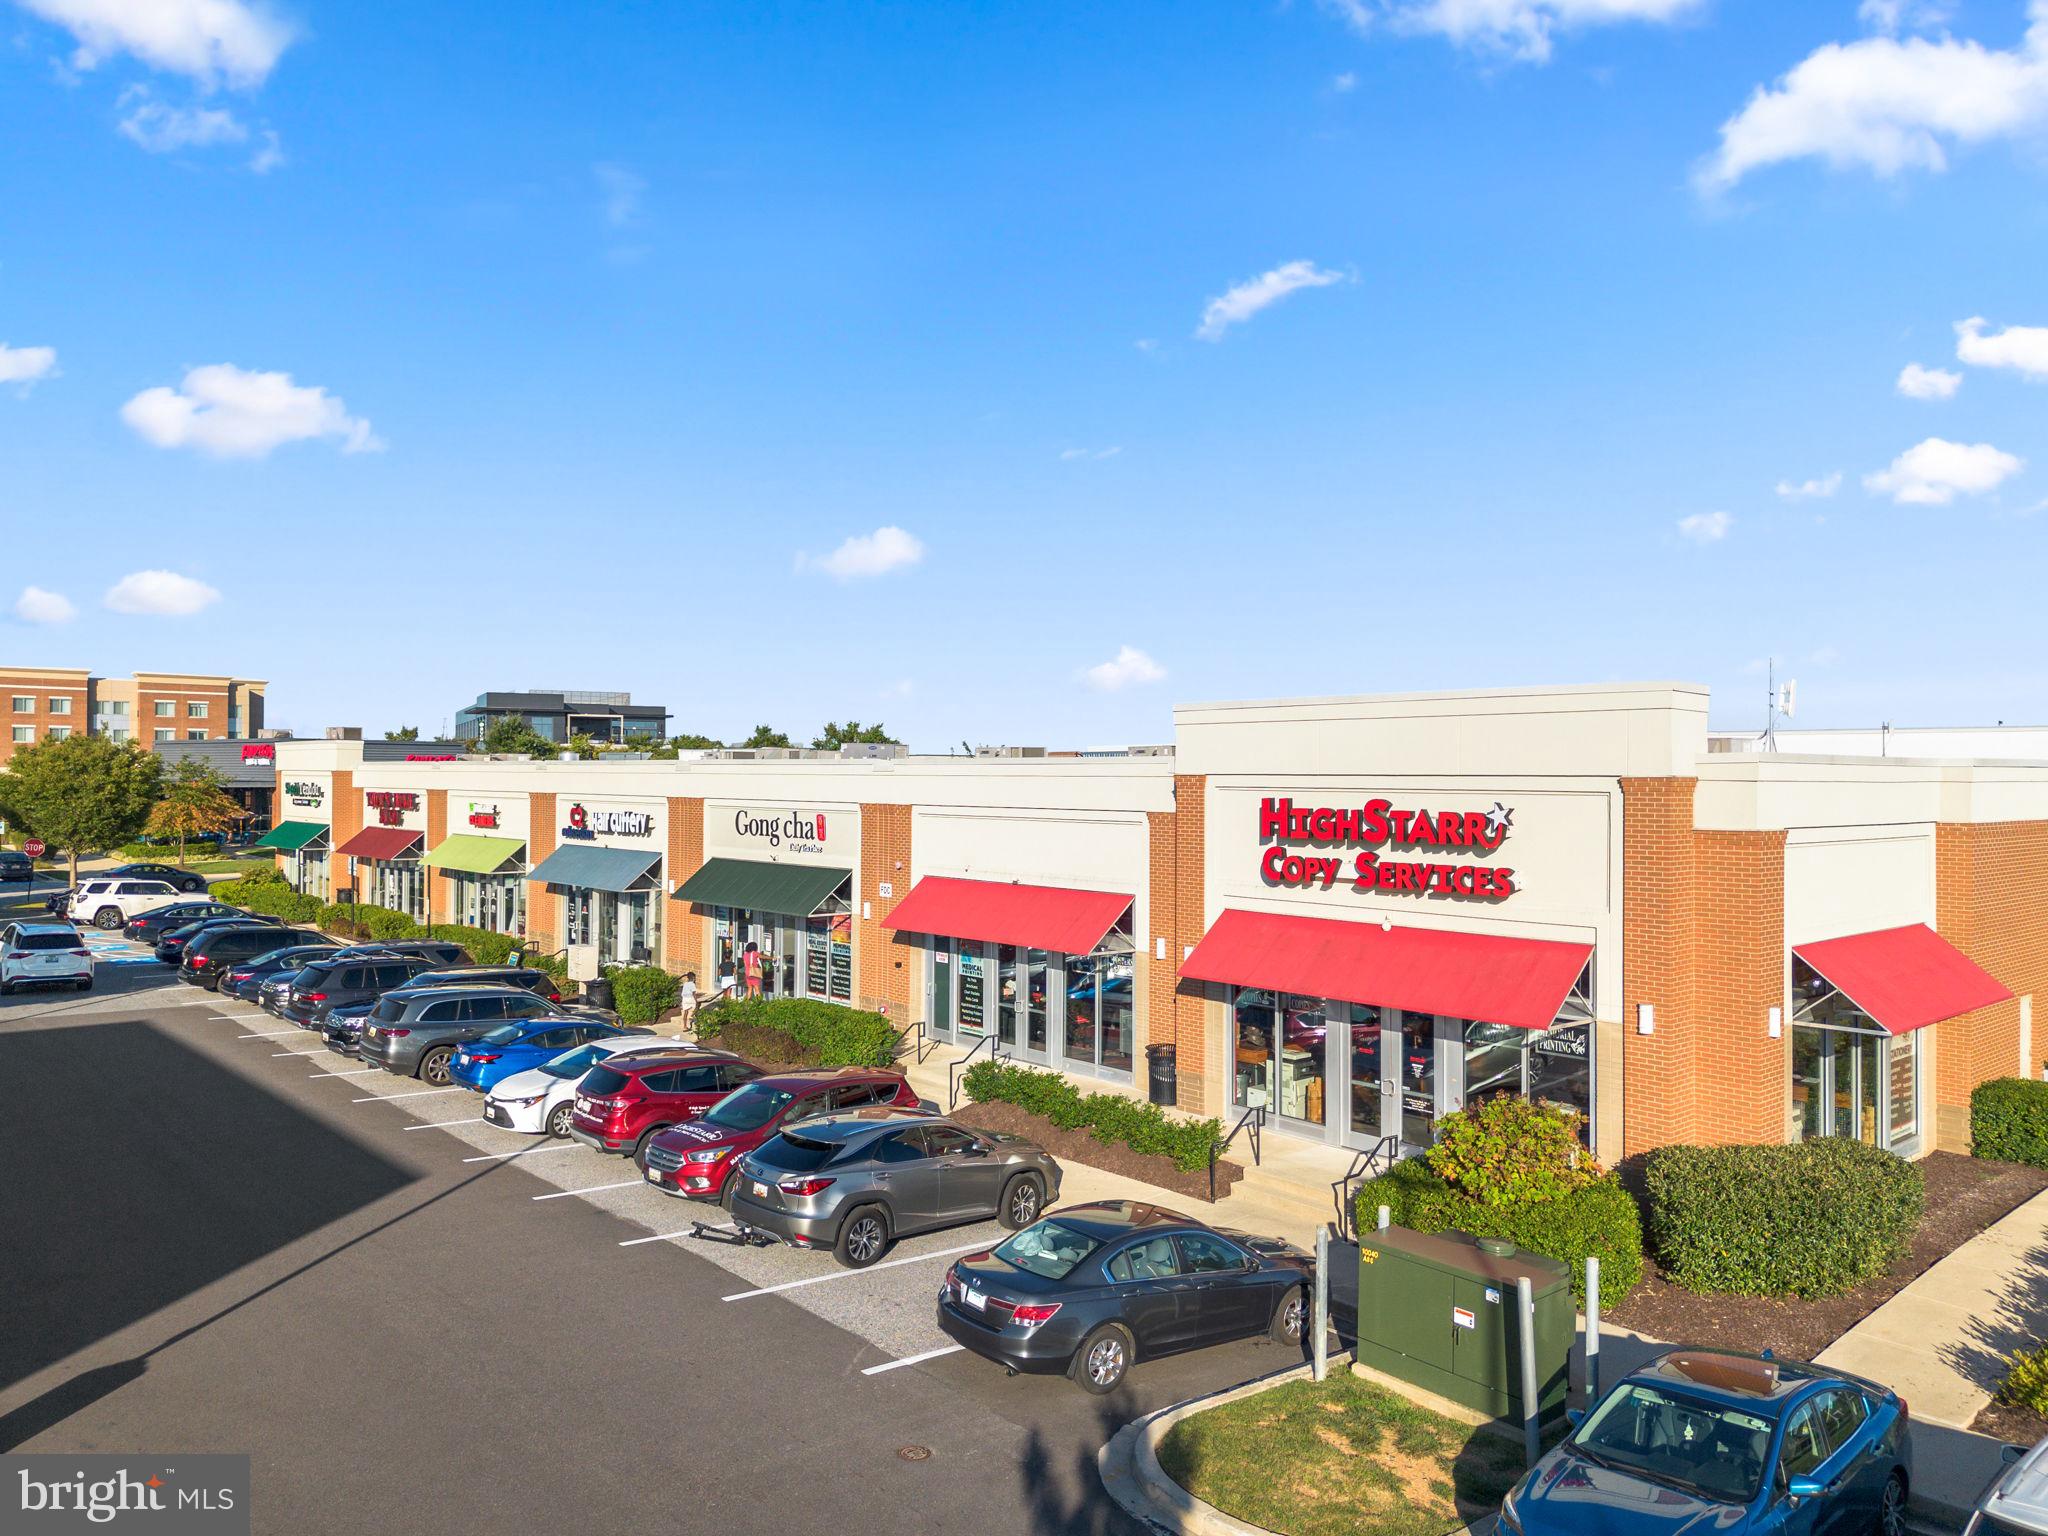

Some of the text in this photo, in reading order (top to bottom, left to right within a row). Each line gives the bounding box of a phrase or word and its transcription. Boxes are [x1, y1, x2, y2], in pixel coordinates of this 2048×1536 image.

[735, 810, 780, 847] Gong
[783, 811, 815, 840] cha
[25, 844, 43, 852] STOP
[1262, 846, 1515, 897] COPY SERVICES
[962, 963, 983, 972] MEDICAL
[1540, 1039, 1572, 1054] PRINTING
